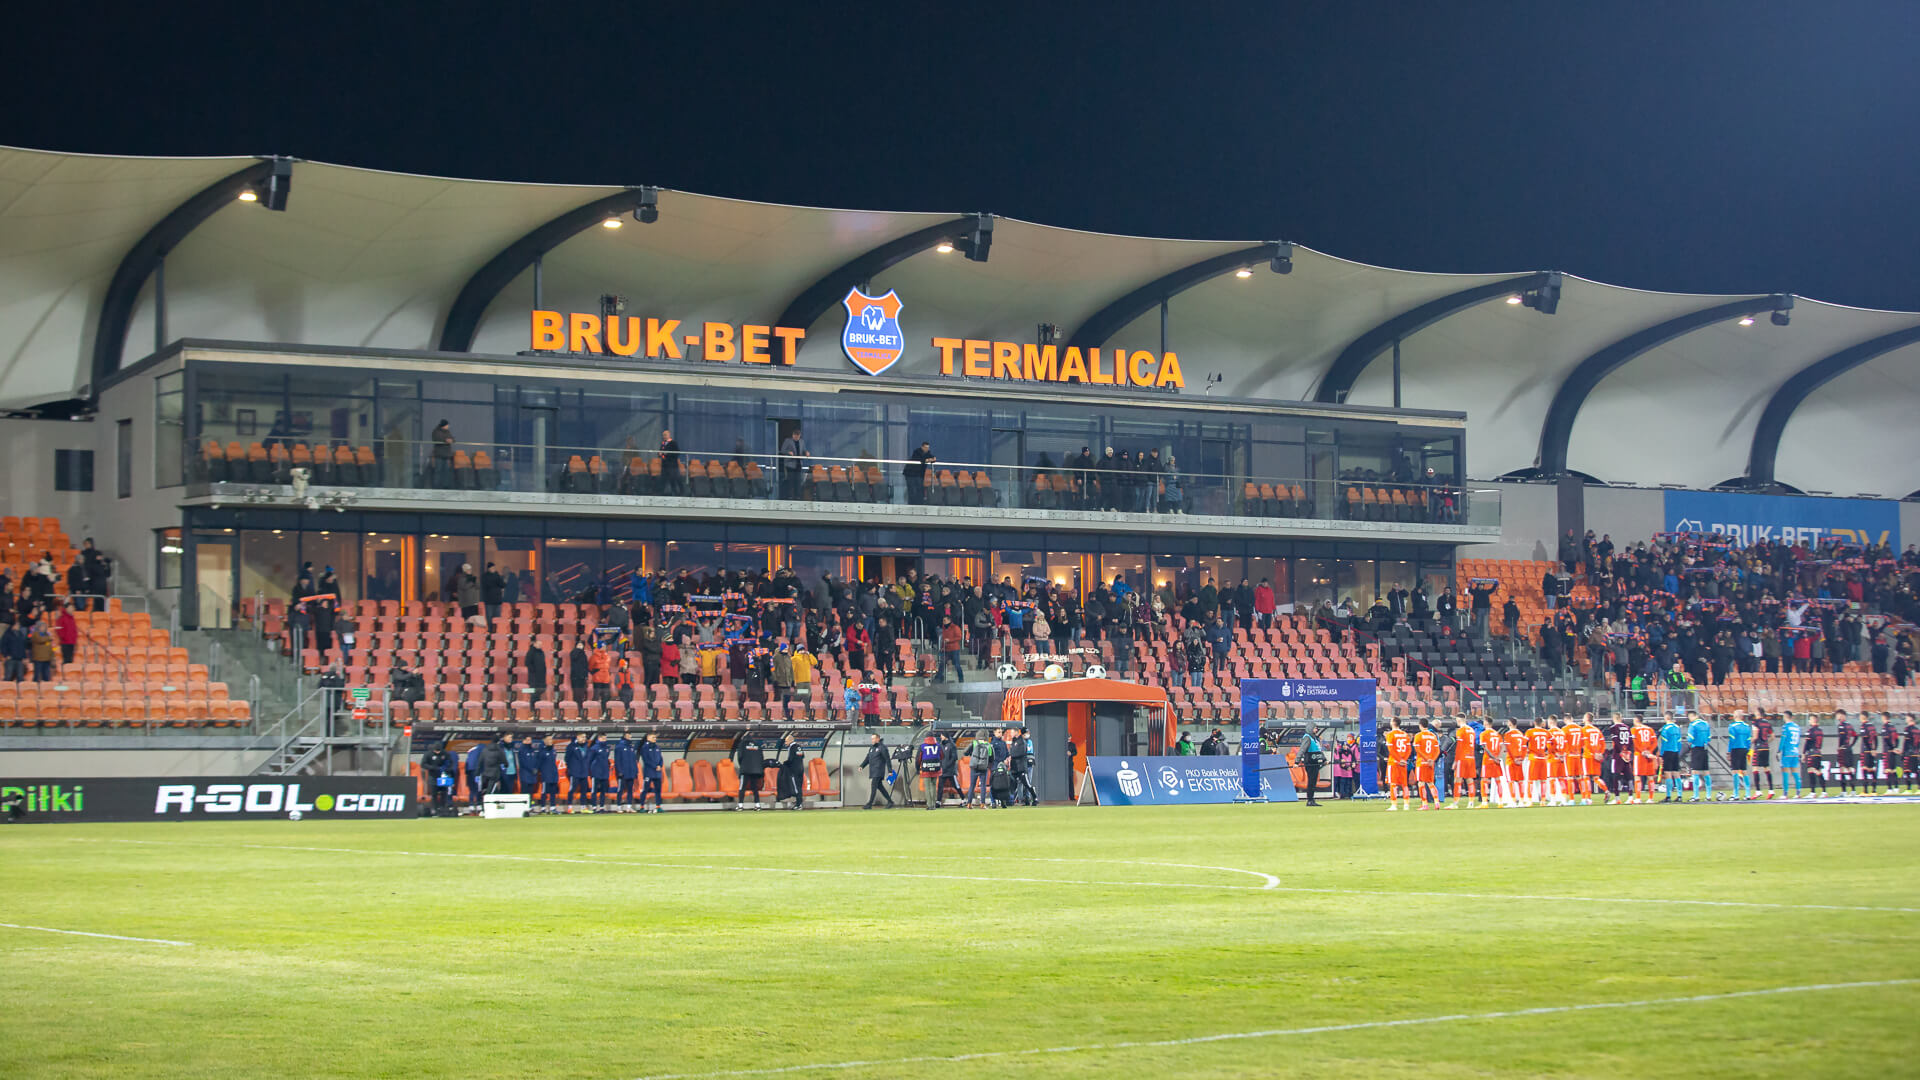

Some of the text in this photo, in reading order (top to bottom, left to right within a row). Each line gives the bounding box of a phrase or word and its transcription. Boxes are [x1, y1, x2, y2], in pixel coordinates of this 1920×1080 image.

[849, 333, 898, 345] BRUK-BET
[531, 310, 1186, 388] BRUK-BET TERMALICA
[857, 351, 892, 360] TERMALICA
[1534, 735, 1547, 750] 13
[1619, 731, 1630, 745] 99
[1637, 729, 1650, 743] 18
[924, 745, 938, 756] TV
[1425, 739, 1432, 754] 8
[1185, 768, 1239, 777] PKO Bank Polski
[1187, 777, 1272, 792] EKSTRAKSA
